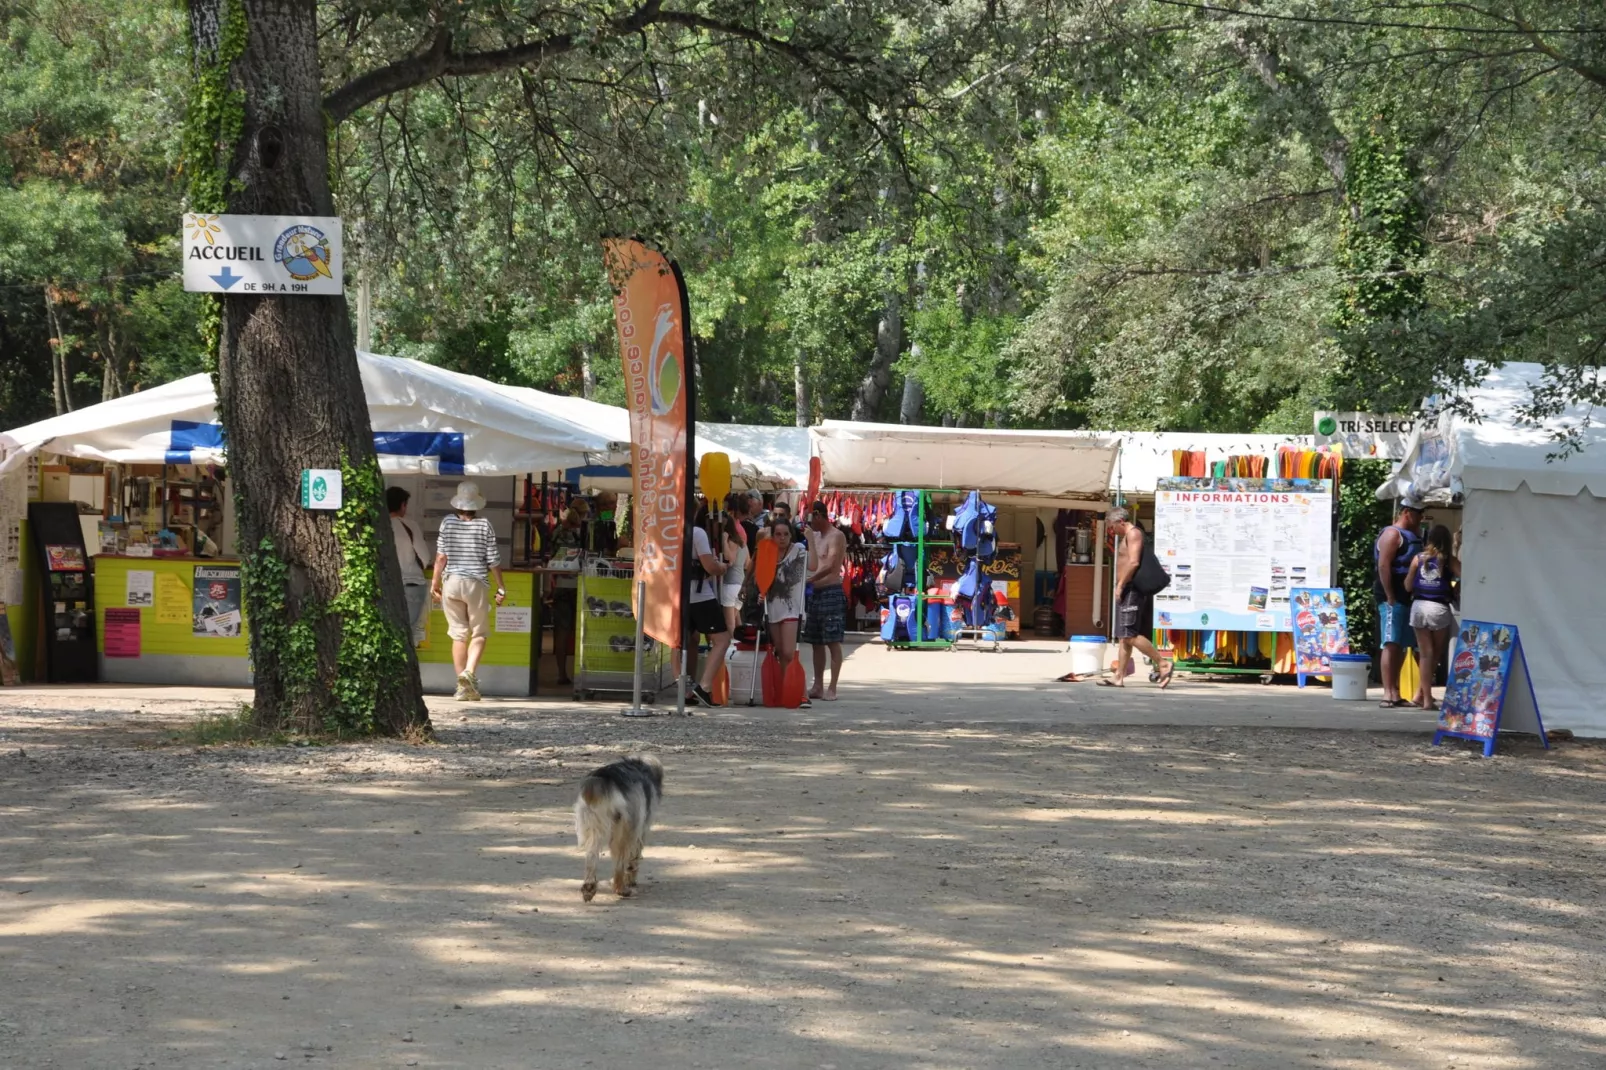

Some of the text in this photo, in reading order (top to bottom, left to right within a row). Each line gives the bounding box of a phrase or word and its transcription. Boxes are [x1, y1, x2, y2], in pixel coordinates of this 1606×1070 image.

[189, 245, 265, 261] ACCUEIL
[244, 283, 256, 291] DE
[279, 283, 287, 291] A
[291, 283, 308, 292] 19H
[1176, 492, 1289, 503] INFORMATIONS
